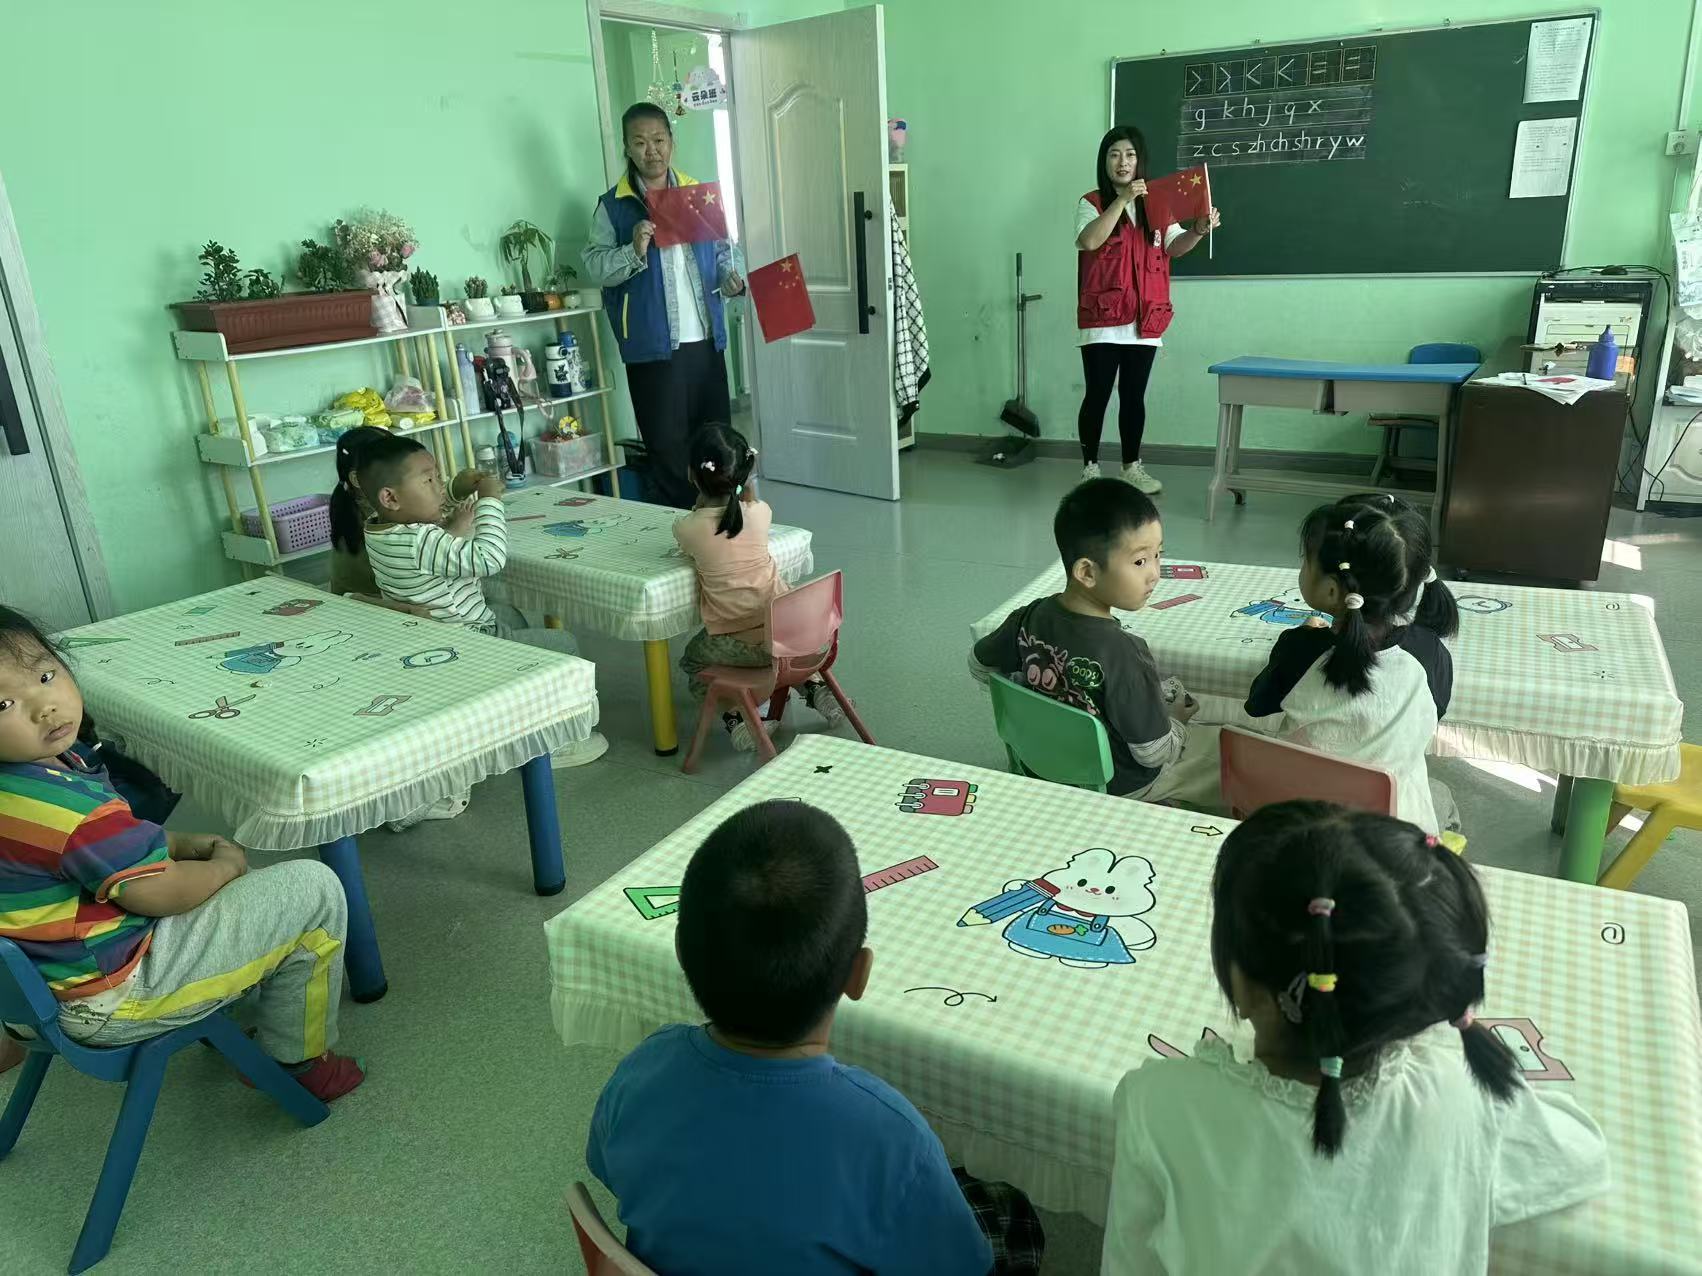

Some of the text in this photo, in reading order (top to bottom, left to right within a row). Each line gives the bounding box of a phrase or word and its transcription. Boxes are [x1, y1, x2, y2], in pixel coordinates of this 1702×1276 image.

[1195, 97, 1322, 131] g k h j q x
[1193, 130, 1365, 160] z c s zh ch sh r y w
